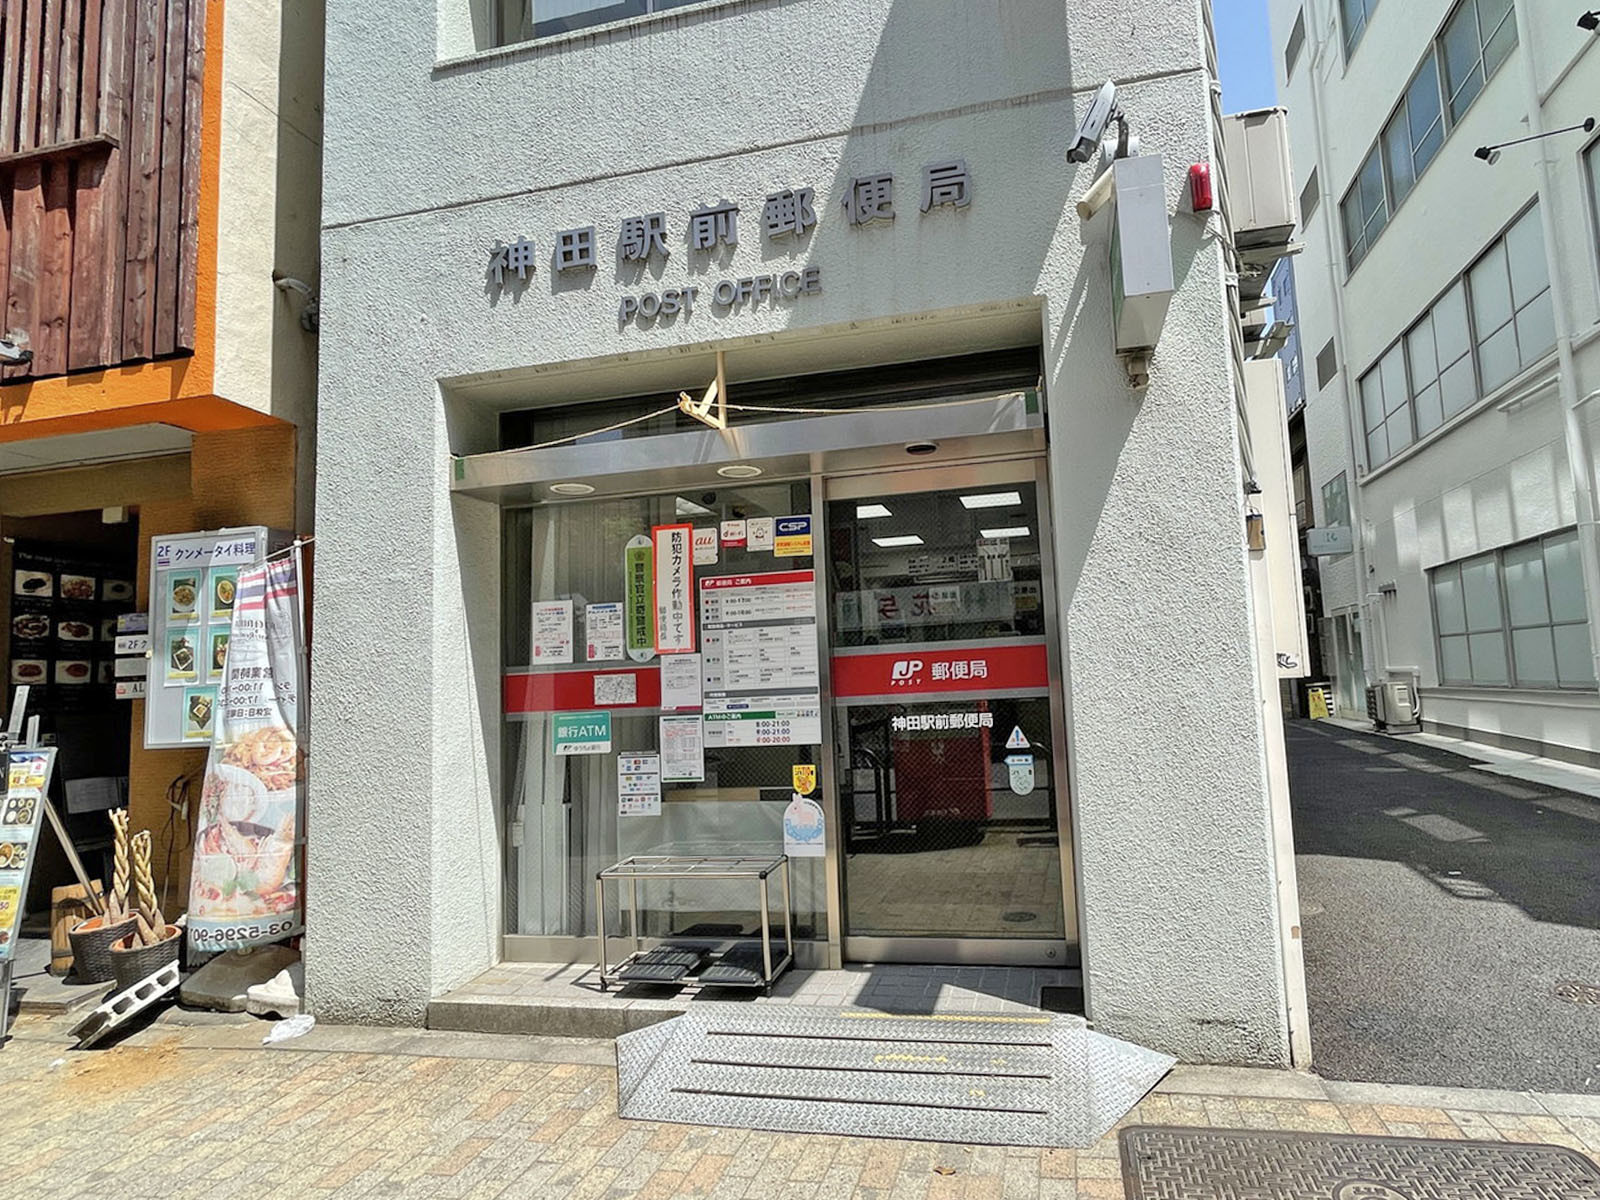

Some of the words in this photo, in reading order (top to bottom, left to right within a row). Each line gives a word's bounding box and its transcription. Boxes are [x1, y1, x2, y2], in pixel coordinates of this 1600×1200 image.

[489, 158, 973, 284] 神田駅前郵便局
[619, 287, 698, 323] POST
[713, 266, 823, 307] OFFICE
[778, 521, 807, 532] CSP
[695, 536, 714, 546] au
[157, 545, 172, 557] 2F
[174, 541, 256, 561] クンメータイ料理
[671, 531, 684, 646] 防犯カメラ作動中です
[128, 639, 138, 650] 2F
[931, 659, 988, 681] 郵便局
[890, 679, 922, 687] POST
[557, 724, 607, 739] 銀行ATM
[891, 713, 994, 732] 神田駅前郵便局
